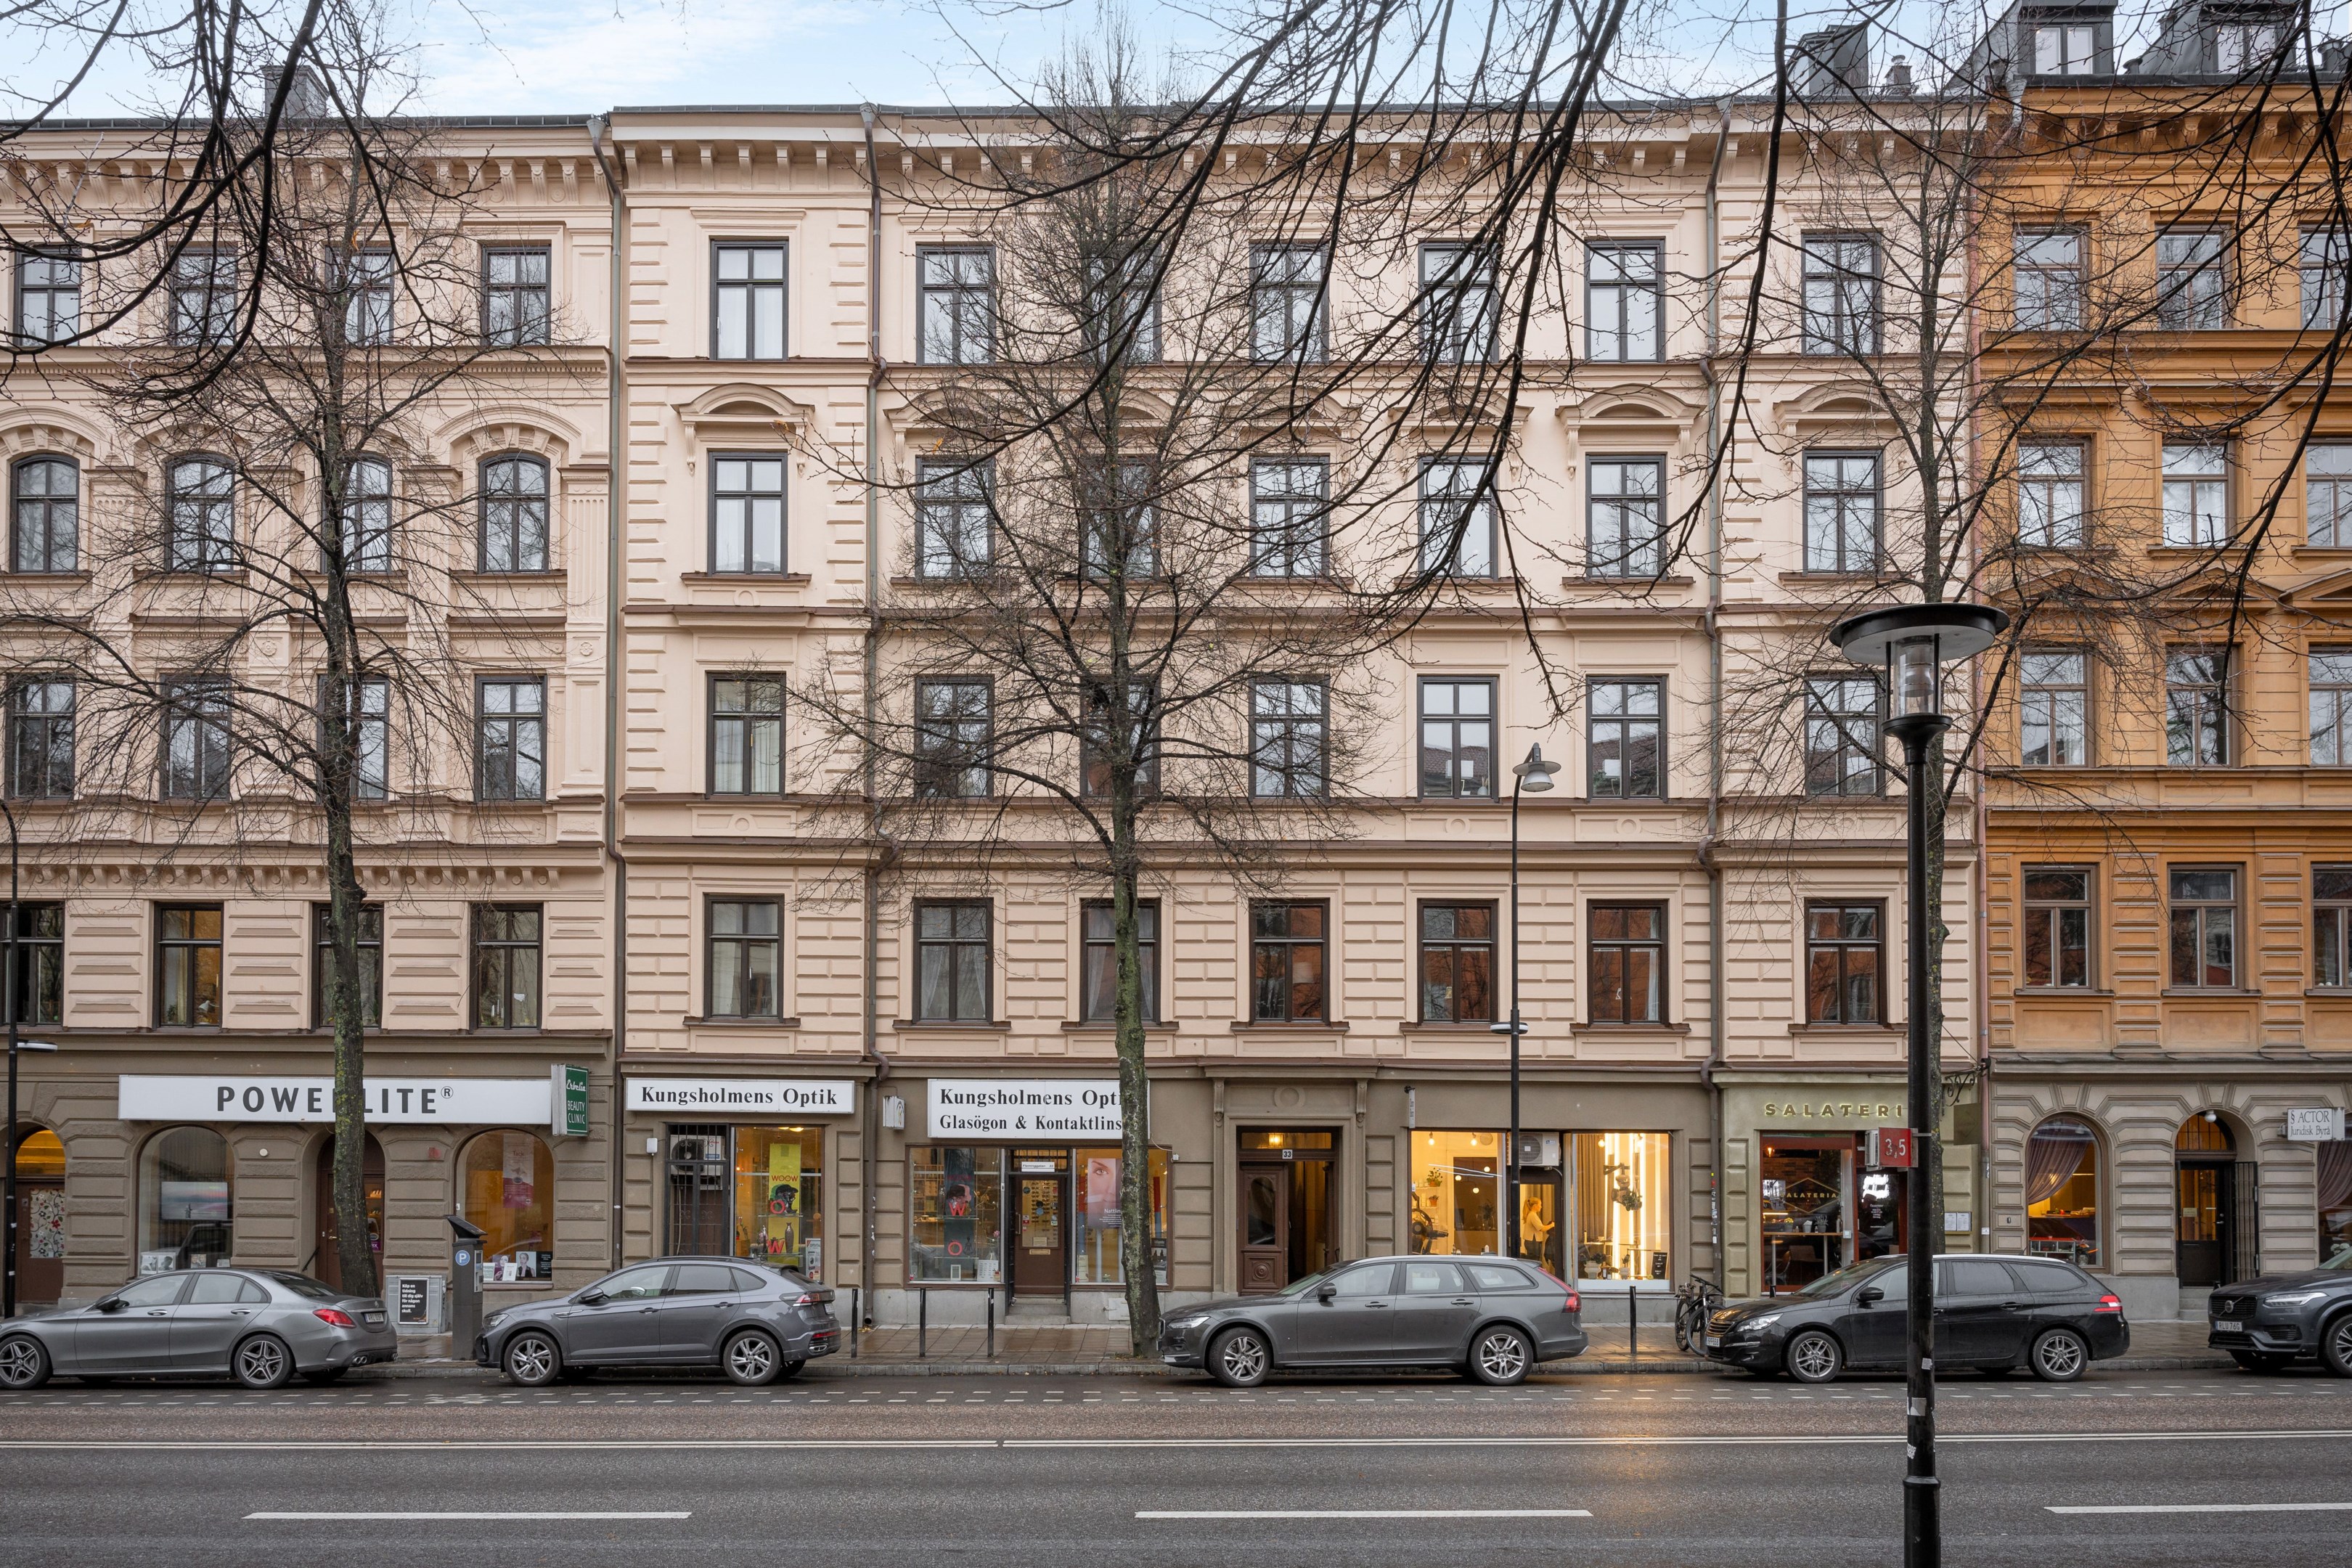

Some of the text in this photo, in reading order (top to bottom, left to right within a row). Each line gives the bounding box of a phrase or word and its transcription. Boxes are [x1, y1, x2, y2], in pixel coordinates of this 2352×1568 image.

[642, 1087, 838, 1108] Kungsholmens Optik
[940, 1089, 1122, 1108] Kungsholmens Opt
[567, 1100, 585, 1111] BEAUTY
[1765, 1103, 1902, 1117] SALATERI
[568, 1113, 585, 1124] CLINIC
[2298, 1110, 2330, 1123] ACTOR
[940, 1115, 1122, 1132] Glasögon & Kontaktlins
[2290, 1124, 2314, 1137] Juridisk
[459, 1253, 467, 1263] P
